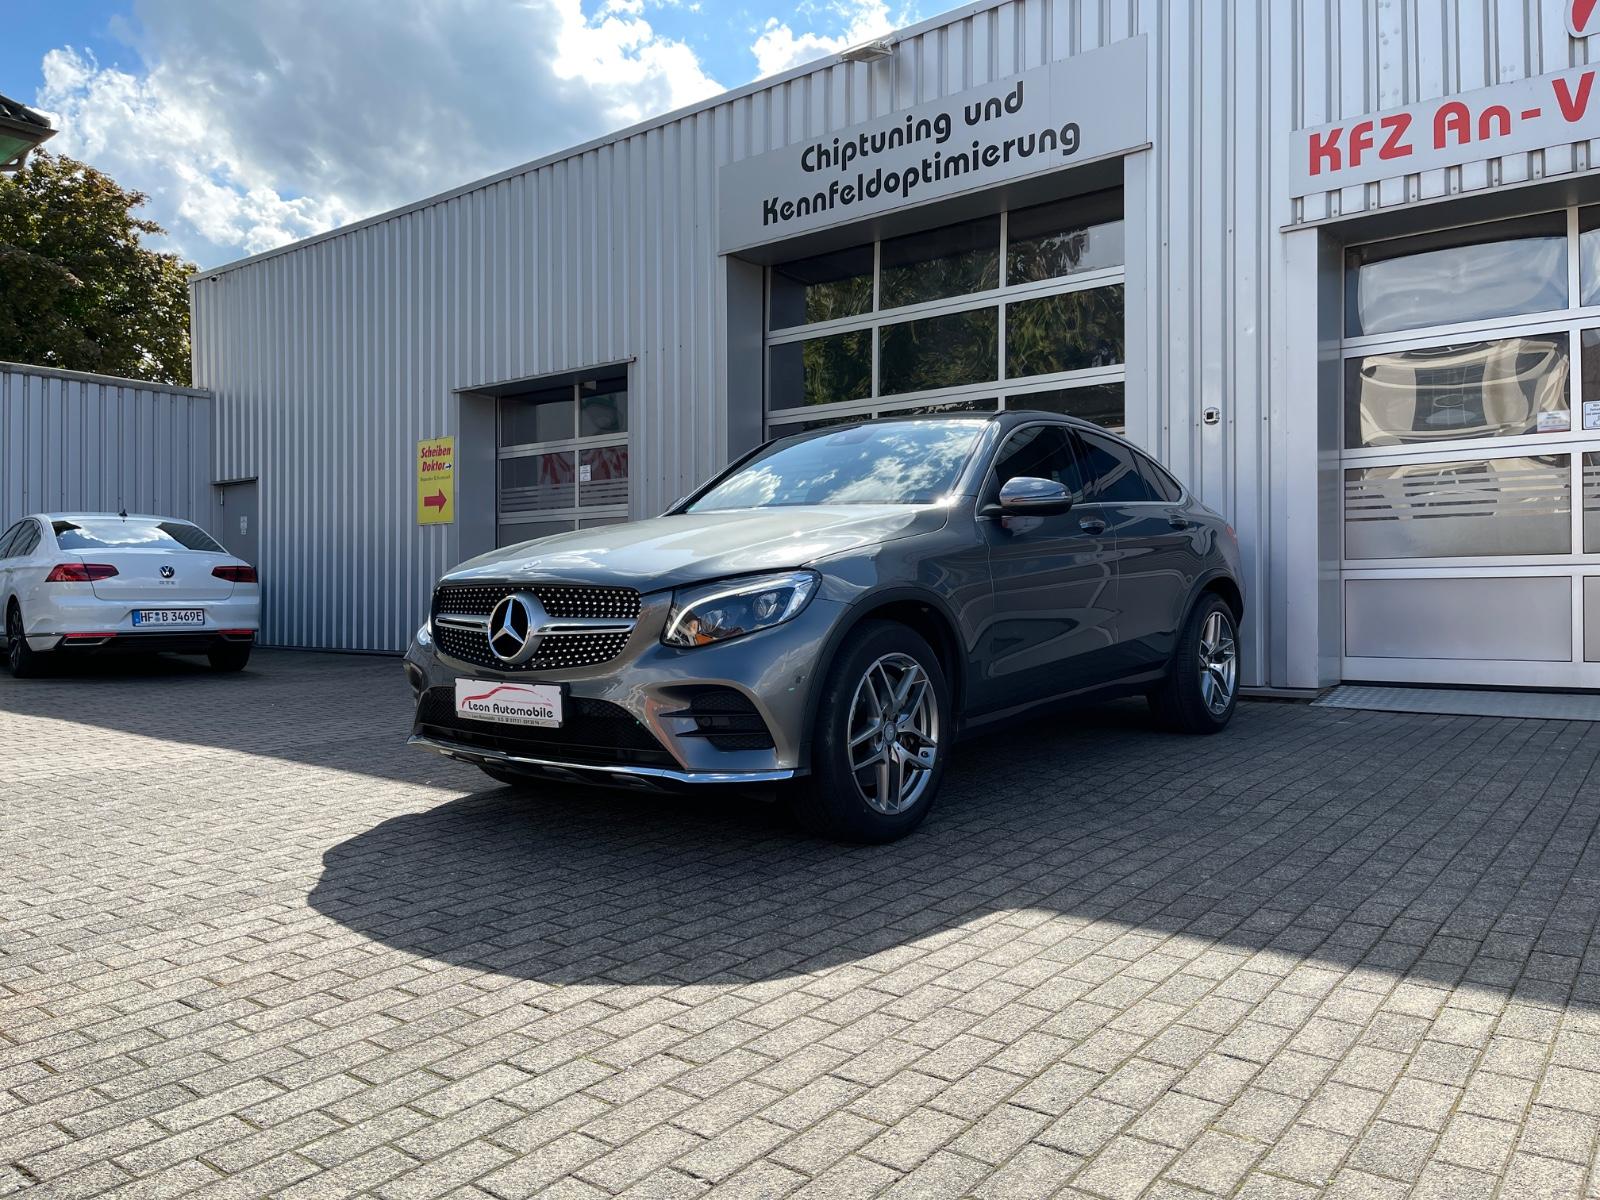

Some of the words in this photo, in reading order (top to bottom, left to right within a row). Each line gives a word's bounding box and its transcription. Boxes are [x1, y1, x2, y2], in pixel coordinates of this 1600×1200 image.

[801, 114, 951, 172] Chiptuning
[965, 81, 1024, 126] und
[763, 122, 1080, 226] Kennfeldoptimierung
[421, 445, 451, 458] Scheiben
[422, 460, 445, 472] Doktor
[140, 612, 153, 622] HF
[161, 612, 169, 621] B
[171, 611, 202, 622] 3469E
[468, 701, 490, 712] Leon
[493, 703, 553, 718] Automobile
